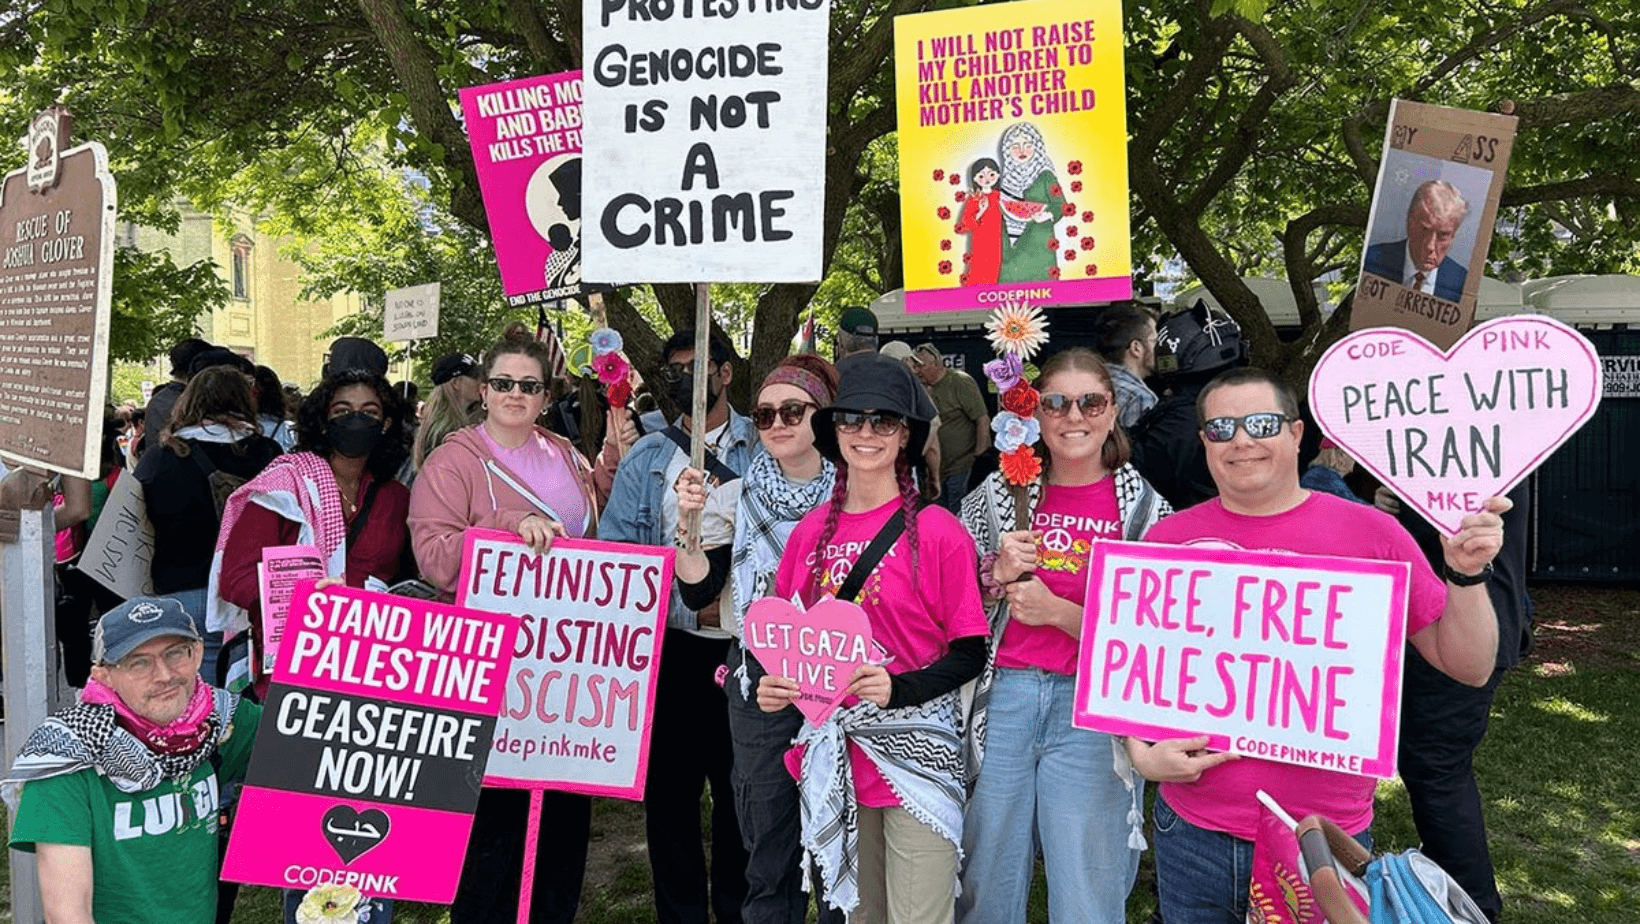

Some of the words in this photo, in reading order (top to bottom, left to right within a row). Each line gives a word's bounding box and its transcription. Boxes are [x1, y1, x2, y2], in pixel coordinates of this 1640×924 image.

[917, 39, 924, 60] I
[931, 34, 978, 59] WILL
[984, 28, 1025, 53] NOT
[1032, 20, 1096, 48] RAISE
[593, 43, 783, 87] GENOCIDE
[918, 61, 947, 83] MY
[953, 47, 1059, 80] CHILDREN
[1065, 43, 1093, 67] TO
[477, 84, 553, 118] KILLING
[918, 80, 962, 105] KILL
[969, 68, 1067, 100] ANOTHER
[496, 112, 537, 140] AND
[624, 99, 668, 133] IS
[690, 90, 781, 132] NOT
[920, 96, 1023, 128] MOTHER'S
[1030, 88, 1096, 116] CHILD
[488, 138, 534, 162] KILLS
[533, 132, 565, 155] THE
[1391, 124, 1418, 149] MY
[1451, 133, 1499, 164] ASS
[681, 142, 719, 190] A
[16, 214, 48, 242] RESCUE
[55, 210, 72, 234] OF
[600, 189, 794, 249] CRIME
[4, 242, 34, 268] JOSHUA
[41, 236, 84, 263] GLOVER
[509, 296, 526, 307] END
[526, 293, 542, 303] THE
[542, 284, 582, 300] GENOCIDE
[976, 287, 1052, 303] CODEPINK
[1361, 275, 1390, 300] GOT
[1394, 289, 1461, 325] ARRESTED
[1347, 340, 1406, 361] CODE
[1482, 330, 1551, 351] PINK
[1342, 374, 1450, 424] PEACE
[1463, 367, 1569, 412] WITH
[1385, 424, 1501, 479] IRAN
[1425, 490, 1480, 512] MKE
[473, 548, 660, 613] FEMINISTS
[302, 591, 412, 643] STAND
[422, 612, 505, 659] WITH
[1109, 566, 1215, 638] FREE,
[1232, 575, 1354, 650] FREE
[750, 621, 793, 650] LET
[799, 626, 868, 663] GAZA
[289, 631, 497, 704] PALESTINE
[782, 657, 836, 691] LIVE
[1100, 638, 1355, 741] PALESTINE
[276, 692, 481, 760] CEASEFIRE
[314, 746, 422, 801] NOW!
[1235, 735, 1360, 772] CODEPINKMKE
